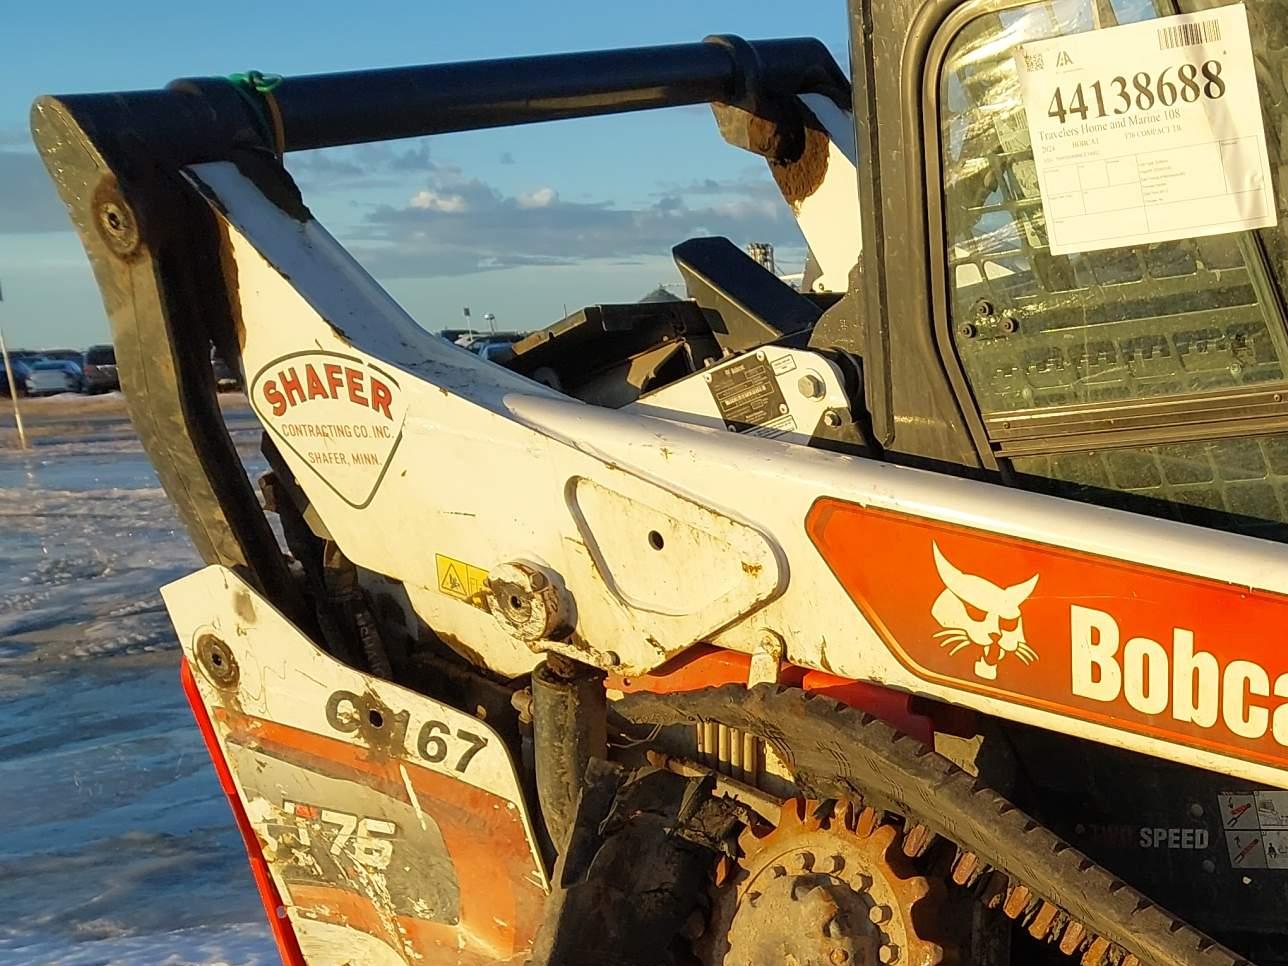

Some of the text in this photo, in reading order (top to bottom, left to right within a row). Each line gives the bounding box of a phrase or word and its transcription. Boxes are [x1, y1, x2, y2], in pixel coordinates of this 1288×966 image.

[1047, 59, 1226, 124] 44138688
[1038, 126, 1079, 142] Travelers
[1080, 122, 1108, 135] Home
[1110, 117, 1126, 129] and
[1128, 113, 1161, 126] Marine
[262, 363, 394, 421] SHAFER
[281, 423, 395, 439] CONTRACTING CO. INC.
[307, 451, 383, 467] SHAFER, MINN.
[1139, 827, 1209, 849] SPEED
